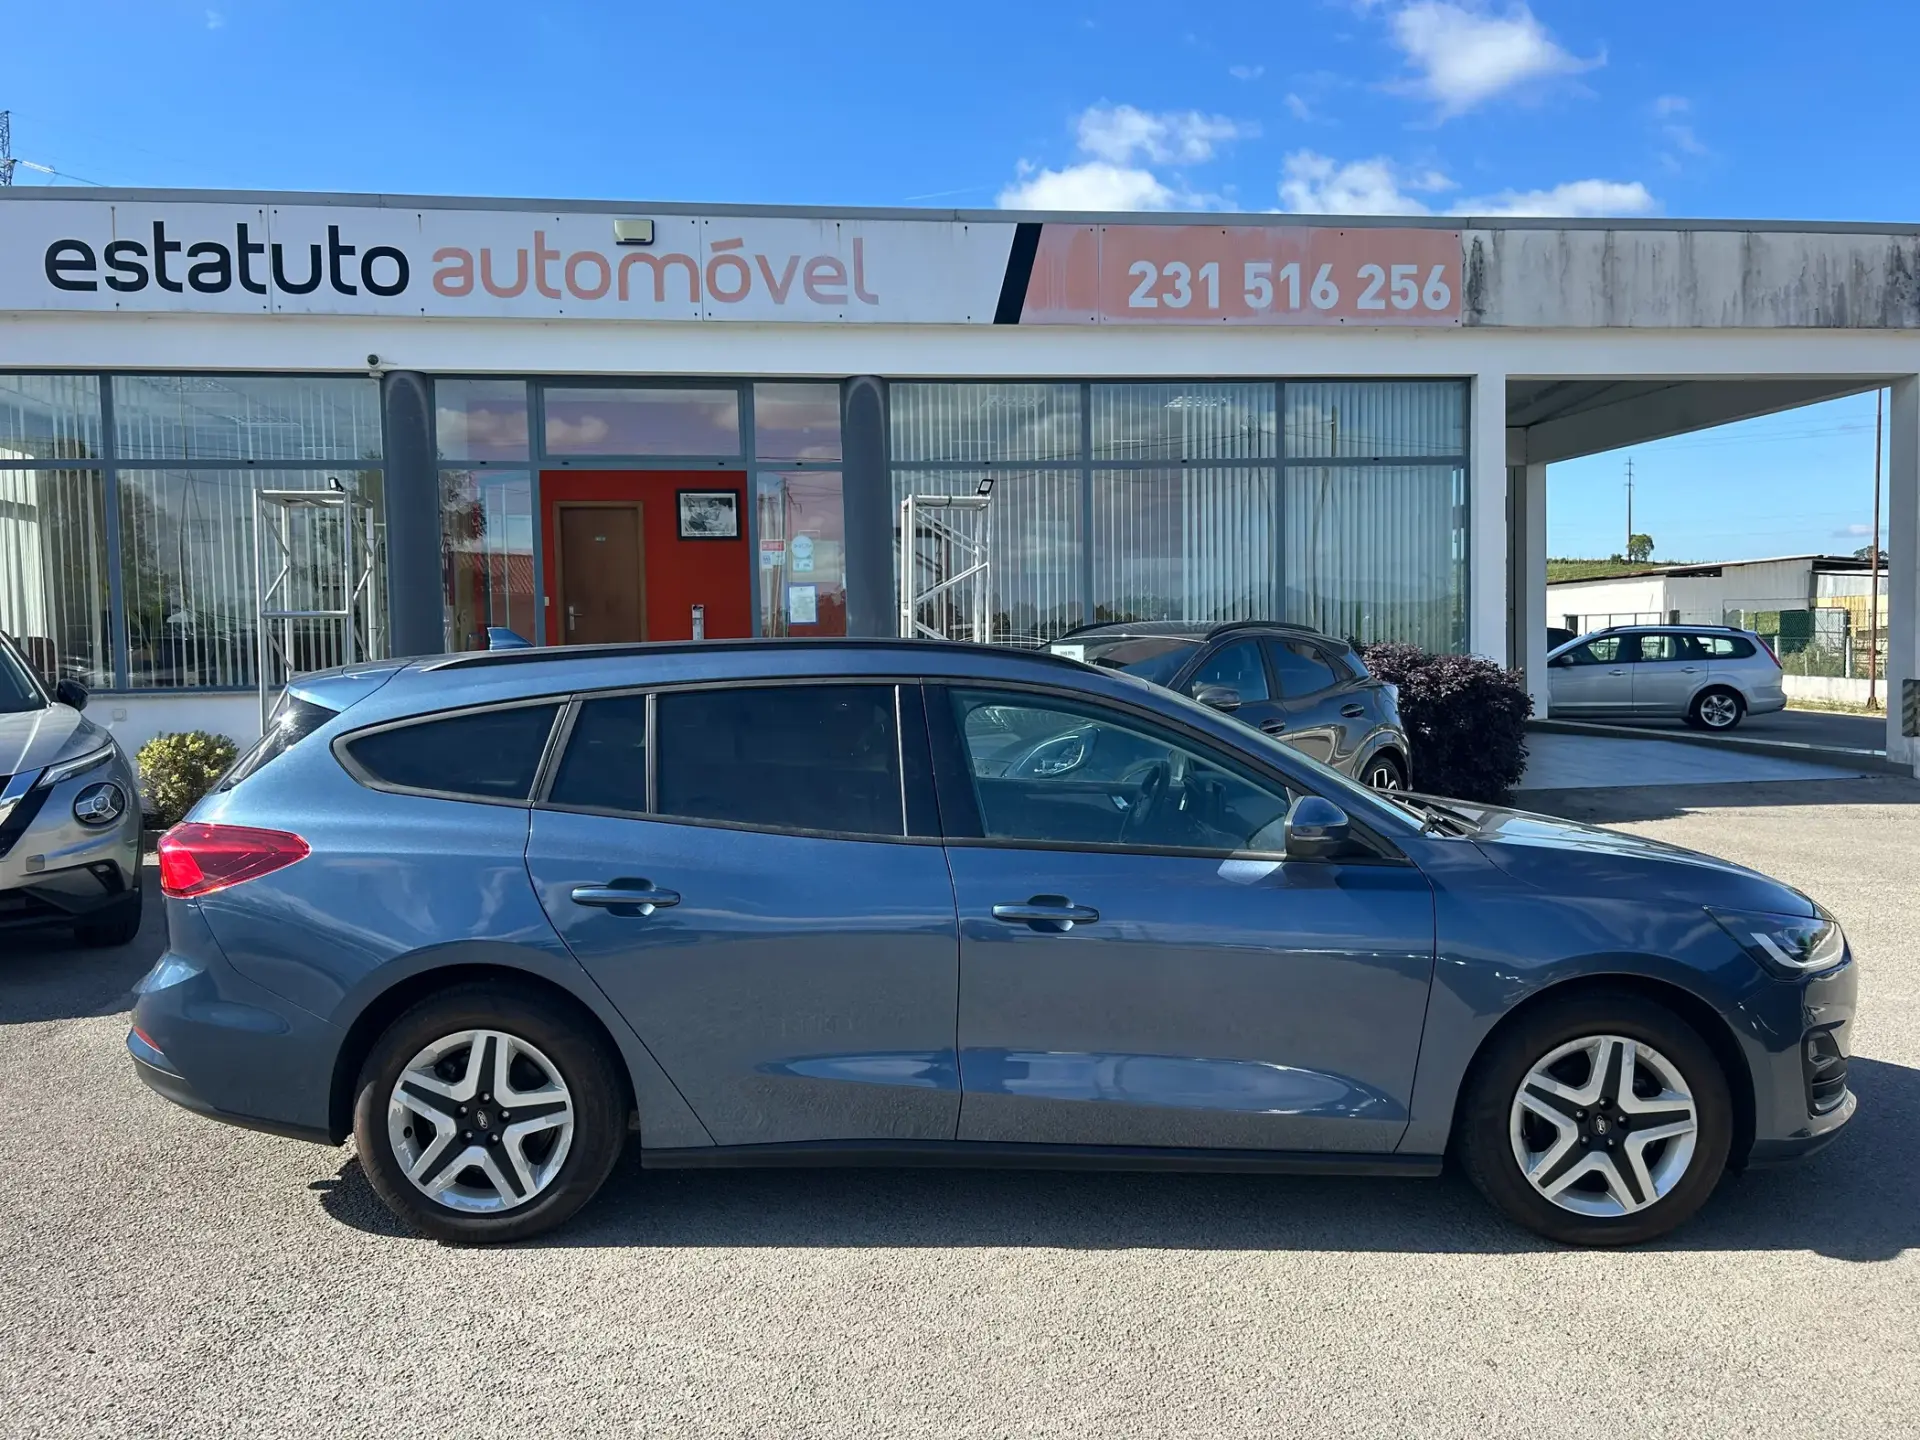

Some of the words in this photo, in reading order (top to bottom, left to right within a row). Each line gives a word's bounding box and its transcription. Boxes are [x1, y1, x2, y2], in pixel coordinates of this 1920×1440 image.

[45, 220, 410, 297] estatuto
[431, 230, 880, 306] automóvel
[1127, 260, 1220, 310] 231
[1243, 261, 1340, 310] 516
[1356, 262, 1451, 312] 256
